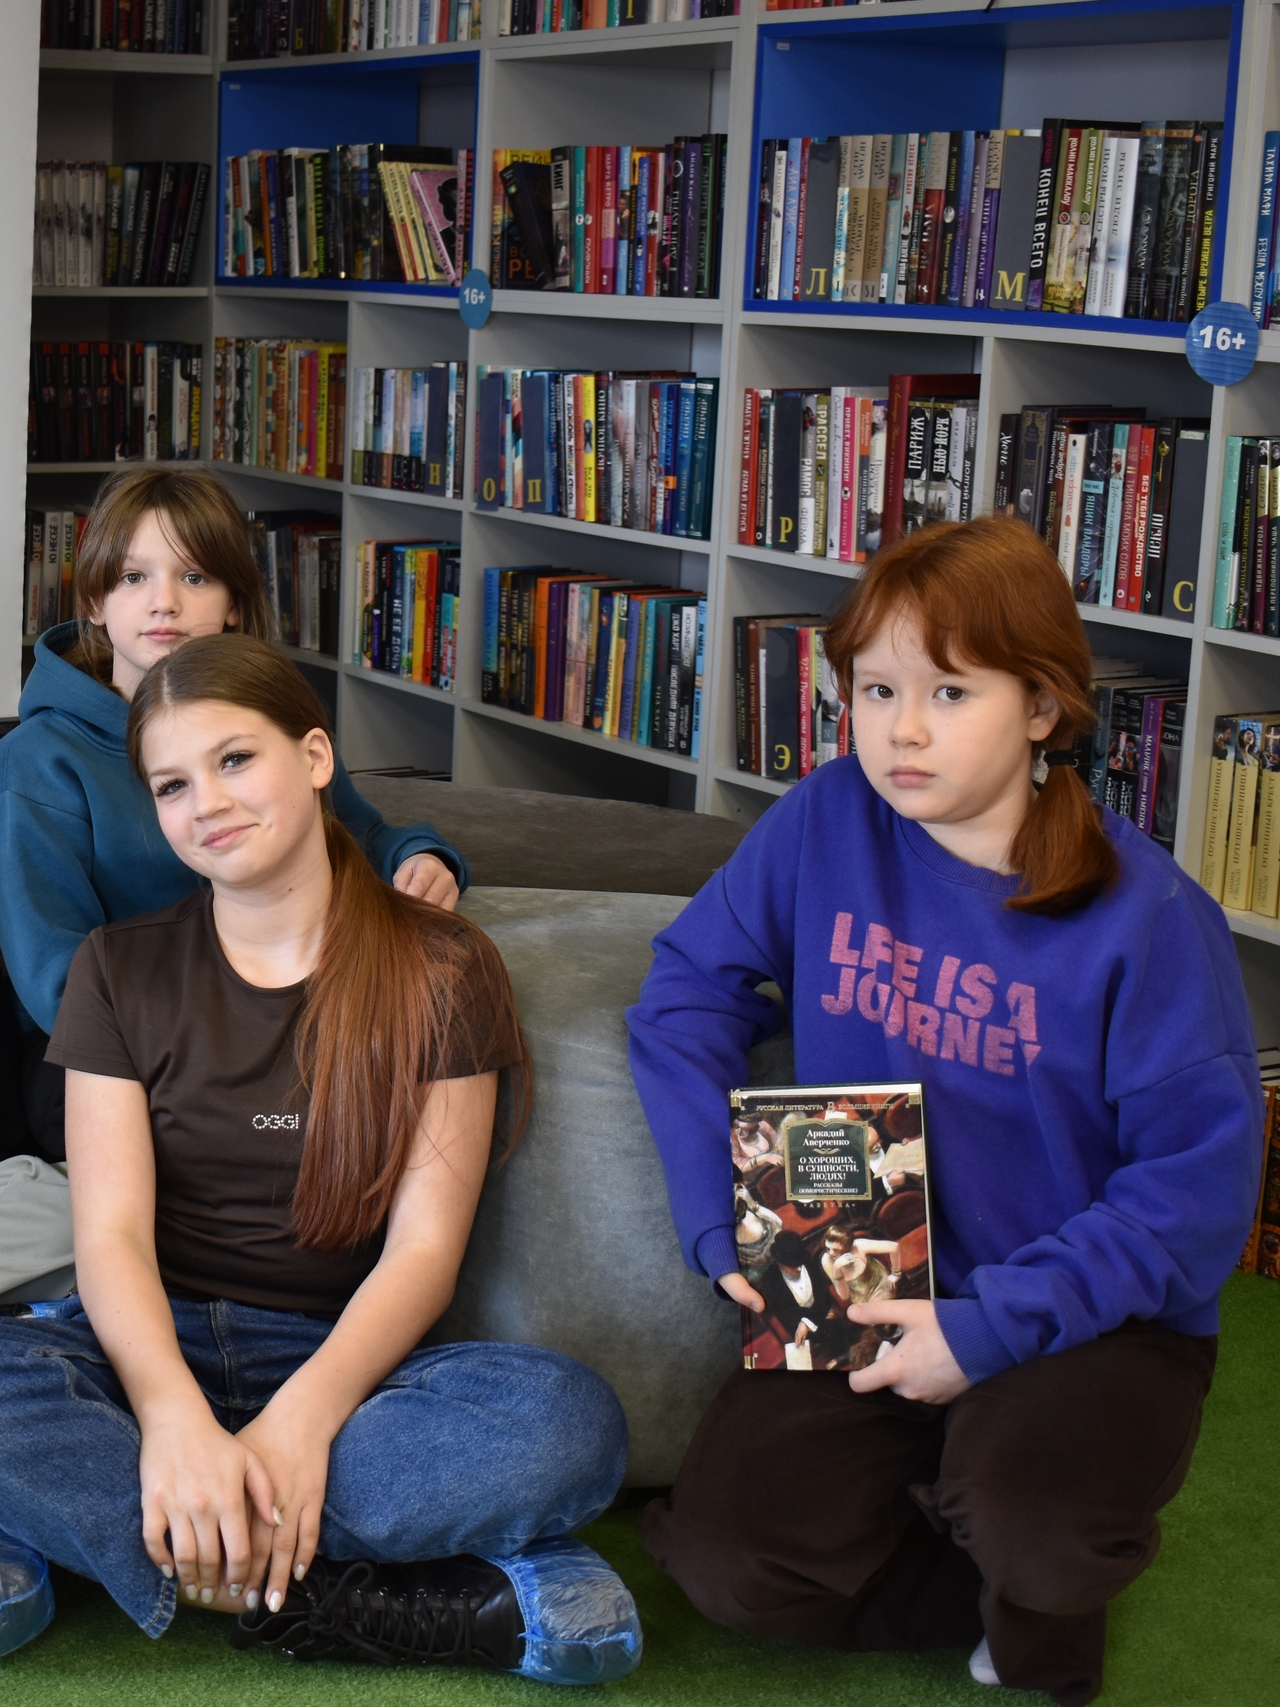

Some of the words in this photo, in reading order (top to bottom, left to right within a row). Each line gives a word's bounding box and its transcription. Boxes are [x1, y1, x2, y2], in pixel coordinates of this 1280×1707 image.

[1067, 137, 1079, 162] КОЛИН
[1087, 136, 1098, 161] КОЛИН
[1210, 137, 1218, 159] МАРК
[552, 162, 564, 191] КИНГ
[604, 153, 612, 180] МАРТА
[787, 168, 800, 193] ЛИА
[949, 157, 958, 192] ЛОНДОН
[1100, 147, 1112, 183] НОЧИ
[1115, 151, 1127, 192] ЗИМЫ
[1206, 162, 1217, 201] ГРИГОРИЙ
[1263, 146, 1276, 185] ТАХИРА
[604, 181, 612, 207] КЕТРО
[699, 165, 710, 214] СМЕРТЬ
[1035, 167, 1053, 220] КОНЕЦ
[1060, 163, 1076, 206] МАККАЛОУ
[1082, 161, 1096, 206] МАККАЛОУ
[1186, 170, 1200, 224] ДОРОГА
[140, 189, 151, 233] КАМЕННАЯ
[671, 190, 680, 226] КУНЦ
[784, 197, 799, 228] ЛУИС
[1095, 186, 1107, 233] СЕСТРЫ
[1110, 196, 1122, 237] ЛЮДИ
[1261, 188, 1272, 217] МАФИ
[1137, 204, 1153, 270] МАККАЛОУ
[1203, 209, 1214, 237] ВЕТРА
[133, 233, 148, 280] ПАЦИЕНТКА
[944, 232, 953, 268] Маленькая
[1029, 222, 1046, 269] ВСЕГО
[1180, 236, 1192, 276] Маккарти
[1199, 238, 1211, 277] ВРЕМЕНИ
[1255, 238, 1269, 269] БЕЗДНА
[463, 288, 486, 305] 16+
[806, 268, 827, 295] Л
[994, 270, 1026, 301] М
[1176, 277, 1188, 306] Кормак
[1195, 279, 1208, 311] ЧЕТЫРЕ
[1253, 271, 1266, 300] МЕЖДУ
[1199, 325, 1246, 351] 16+
[597, 389, 607, 422] КИНО
[681, 398, 690, 440] ПИЛЧЕР
[699, 398, 708, 440] ПИЛЧЕР
[816, 409, 828, 461] РАССЕЛ
[842, 406, 851, 440] ПРИВЕТ,
[597, 424, 607, 471] НОЧНОЕ
[931, 416, 950, 474] НЬЮ-ЙОРК
[1057, 431, 1067, 451] люди
[800, 458, 813, 496] РАМОС
[842, 440, 851, 483] ВИКИНГИ!
[1046, 469, 1055, 484] Тень
[1054, 451, 1065, 480] Добрые
[483, 477, 496, 501] О
[527, 479, 542, 502] П
[861, 469, 869, 512] КНИЖНАЯ
[963, 459, 972, 500] ДОЛГИЙ
[1141, 475, 1150, 493] БЕЗ
[759, 485, 767, 527] ОСВЕНЦИМА
[1083, 494, 1096, 525] ЯЩИК
[1110, 481, 1122, 514] Девочка
[1122, 479, 1135, 521] ТИШИНА
[1139, 495, 1149, 522] ТЕБЯ
[779, 516, 794, 543] Р
[799, 507, 809, 546] ФЕРМА
[859, 513, 868, 536] ДАМА
[1120, 522, 1132, 550] МОИХ
[1241, 504, 1251, 547] каракасе
[1257, 525, 1265, 547] ГРОЗА
[32, 553, 40, 565] Ю
[48, 553, 57, 565] Ю
[64, 552, 72, 563] Ю
[1080, 527, 1095, 577] ПАНДОРЫ
[1118, 552, 1130, 580] СЛОВ
[1134, 523, 1147, 578] РОЖДЕСТВО
[1255, 549, 1264, 593] НЕДВИЖНАЯ
[1269, 547, 1278, 605] ПЕРЕПОЛНИЛАСЬ
[29, 584, 38, 621] Тараканы
[393, 598, 402, 616] НЕ
[500, 587, 508, 613] ТОМАС
[511, 589, 519, 615] ТОМАС
[1172, 580, 1195, 612] С
[392, 618, 401, 633] ЕЕ
[671, 612, 681, 632] ДЖО
[391, 635, 401, 670] ДОЧЬ
[671, 632, 680, 652] ХАРТ
[654, 685, 662, 706] УНА
[669, 664, 678, 710] ПОСЛЕДНЯЯ
[800, 680, 810, 714] Лучше,
[653, 708, 662, 733] ХАРТ
[667, 710, 678, 749] ДЕВУШКА
[774, 744, 791, 771] Э
[799, 736, 808, 769] друзья
[1142, 734, 1153, 772] МАЛЬЧИК
[1266, 777, 1275, 807] КРЕСТ
[1137, 793, 1148, 830] ИМЕНЕМ
[1207, 761, 1223, 858] ПУТЕШЕСТВЕННИЦА
[1232, 767, 1249, 865] ПУТЕШЕСТВЕННИЦА
[1260, 809, 1273, 869] ОГНЕННЫЙ
[934, 955, 997, 1019] IS
[1006, 982, 1038, 1042] A
[252, 1113, 299, 1130] OGGI
[806, 1128, 845, 1138] Аркадий
[802, 1138, 850, 1148] Аверченко
[805, 1165, 859, 1173] СУЩНОСТИ,
[808, 1156, 857, 1165] ХОРОШИХ,
[809, 1172, 846, 1180] ЛЮДЯХ!
